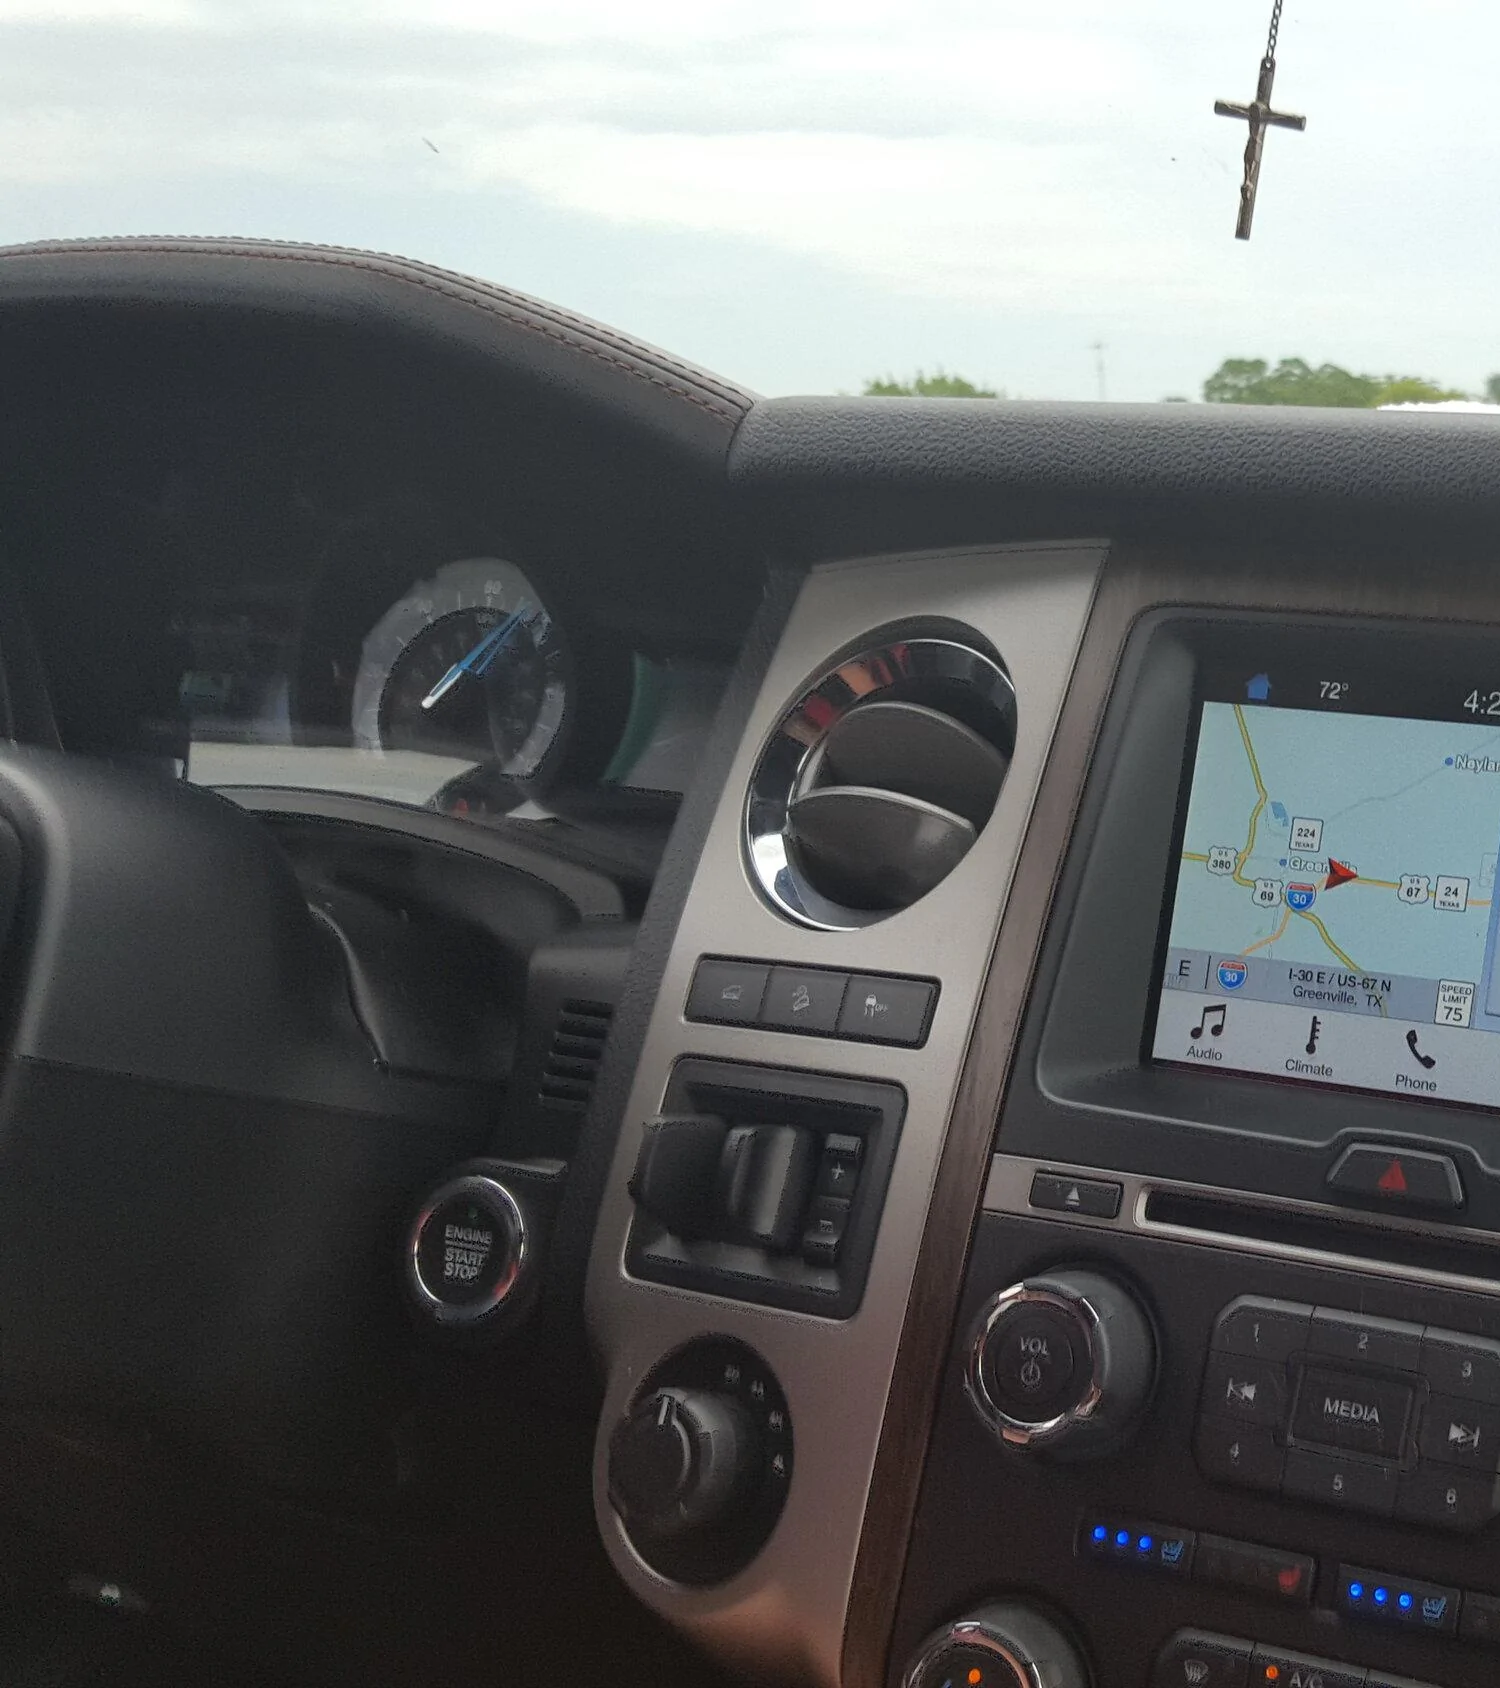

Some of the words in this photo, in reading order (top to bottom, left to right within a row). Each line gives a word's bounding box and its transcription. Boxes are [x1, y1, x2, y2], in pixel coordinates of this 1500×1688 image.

[1297, 827, 1316, 838] 224
[1212, 859, 1231, 870] 380
[1260, 891, 1274, 902] 69
[1293, 893, 1307, 905] 30
[1406, 887, 1421, 898] 67
[1444, 886, 1459, 897] 24
[1179, 960, 1191, 977] E
[1225, 971, 1238, 983] 30
[1289, 968, 1313, 982] I-30
[1317, 972, 1326, 984] E
[1338, 974, 1377, 990] US-67
[1381, 980, 1391, 992] N
[1293, 985, 1357, 1006] Greenville,
[1366, 994, 1382, 1007] TX
[1441, 984, 1472, 995] SPEED
[1442, 994, 1467, 1005] LIMIT
[1443, 1006, 1462, 1021] 75
[1186, 1046, 1222, 1061] Audio
[1285, 1059, 1333, 1077] Climate
[1395, 1074, 1437, 1092] Phone
[445, 1224, 493, 1244] ENGINE
[445, 1248, 487, 1265] START
[444, 1262, 478, 1280] STOP
[1253, 1323, 1260, 1342] 1
[1020, 1336, 1049, 1355] VOL
[1358, 1333, 1368, 1350] 2
[1324, 1397, 1380, 1424] MEDIA
[1333, 1474, 1343, 1491] 5
[1446, 1488, 1456, 1504] 6
